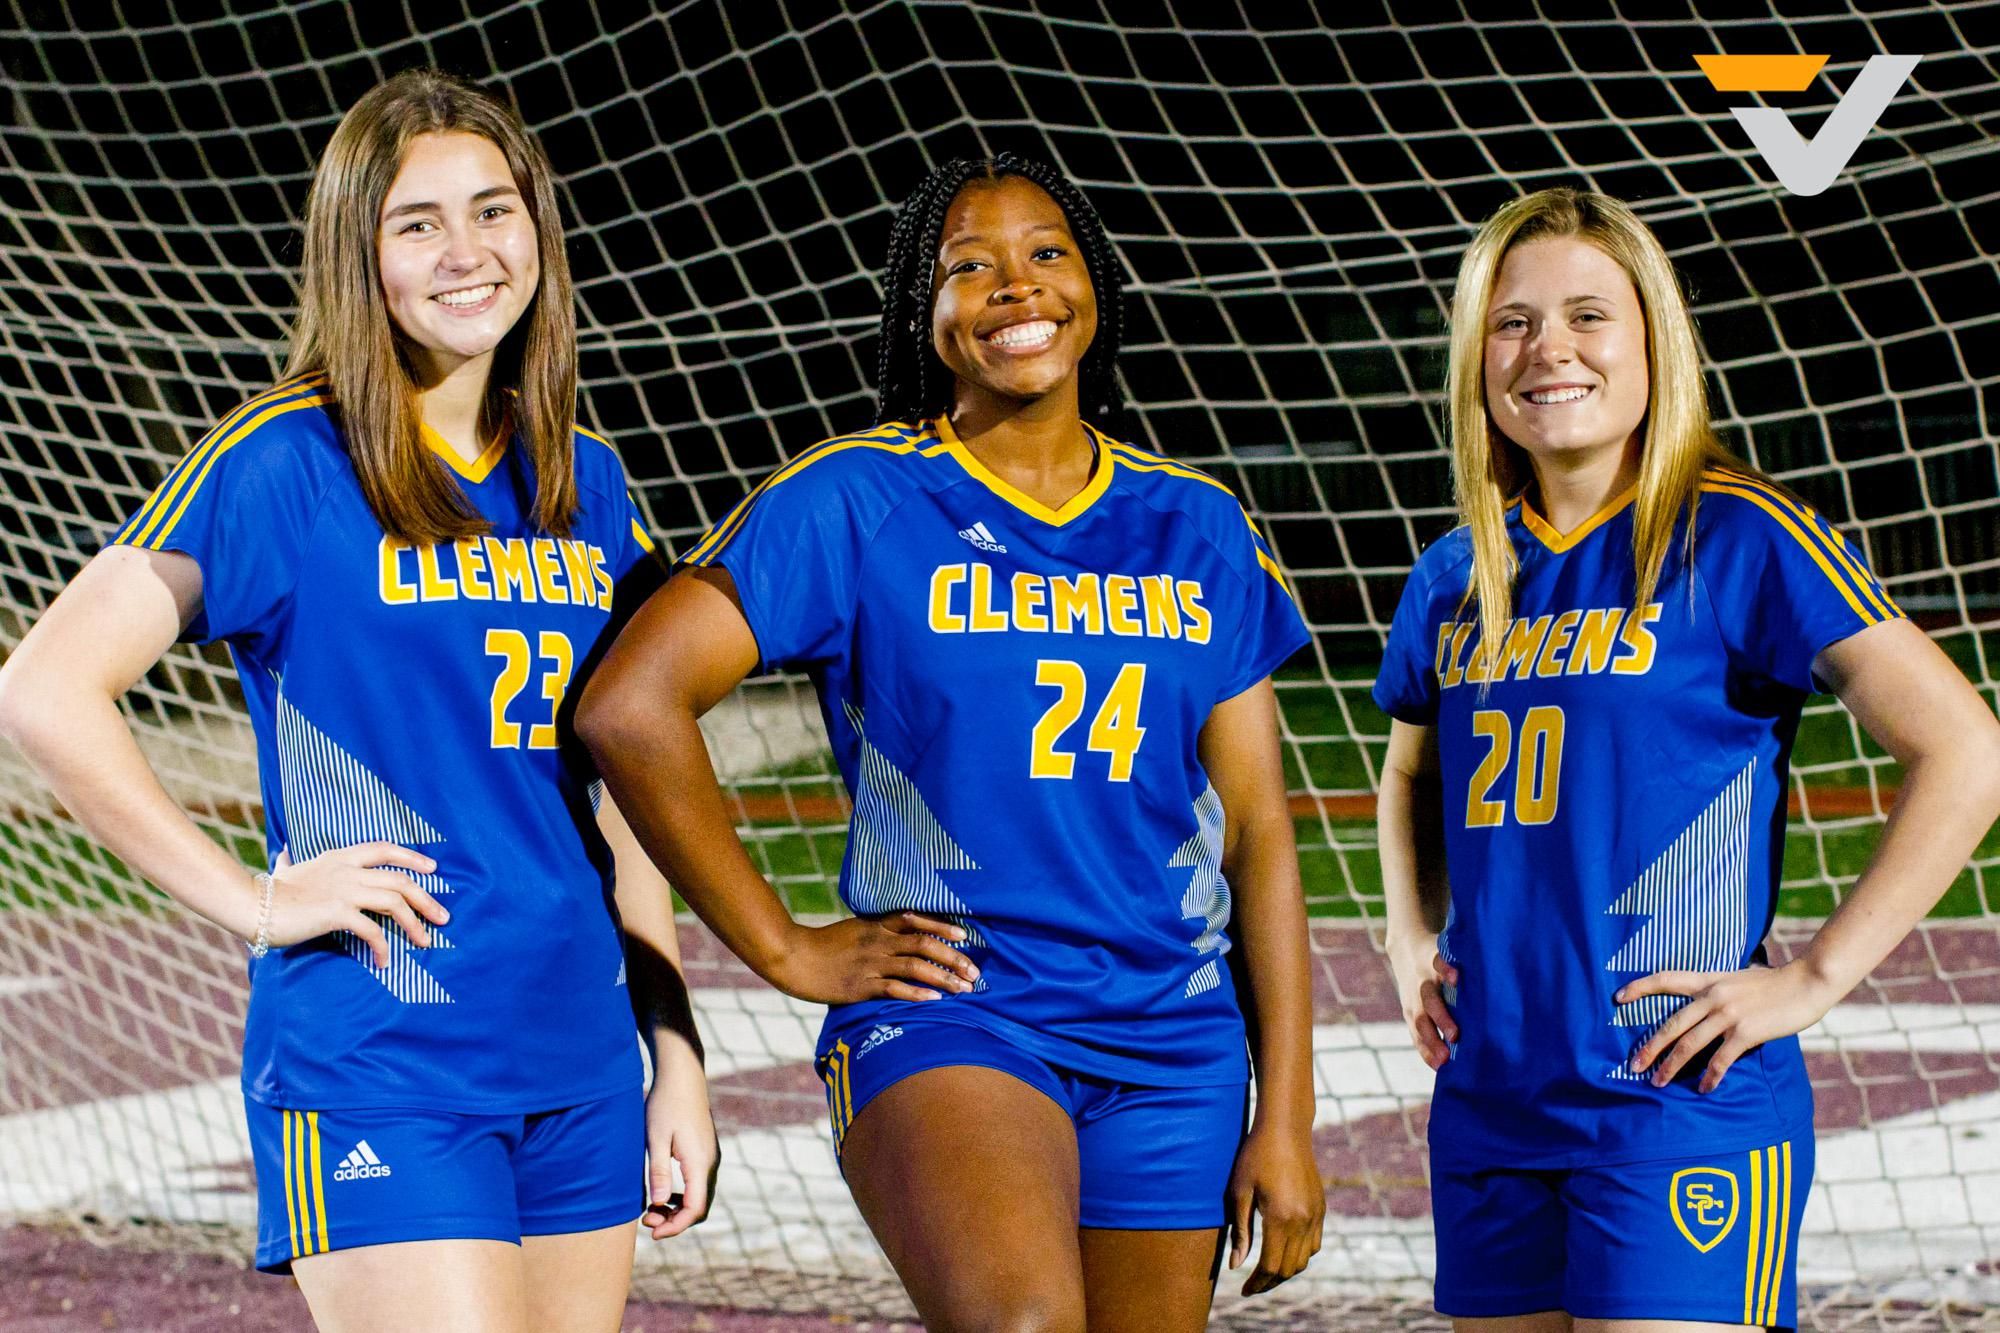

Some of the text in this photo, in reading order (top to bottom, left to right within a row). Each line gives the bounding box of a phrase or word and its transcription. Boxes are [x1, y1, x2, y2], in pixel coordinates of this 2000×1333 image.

[379, 534, 614, 612] CLEMENS
[928, 562, 1212, 645] CLEMENS
[485, 628, 574, 750] 23
[1030, 659, 1147, 782] 24
[1465, 705, 1566, 829] 20
[333, 1164, 391, 1182] adidas
